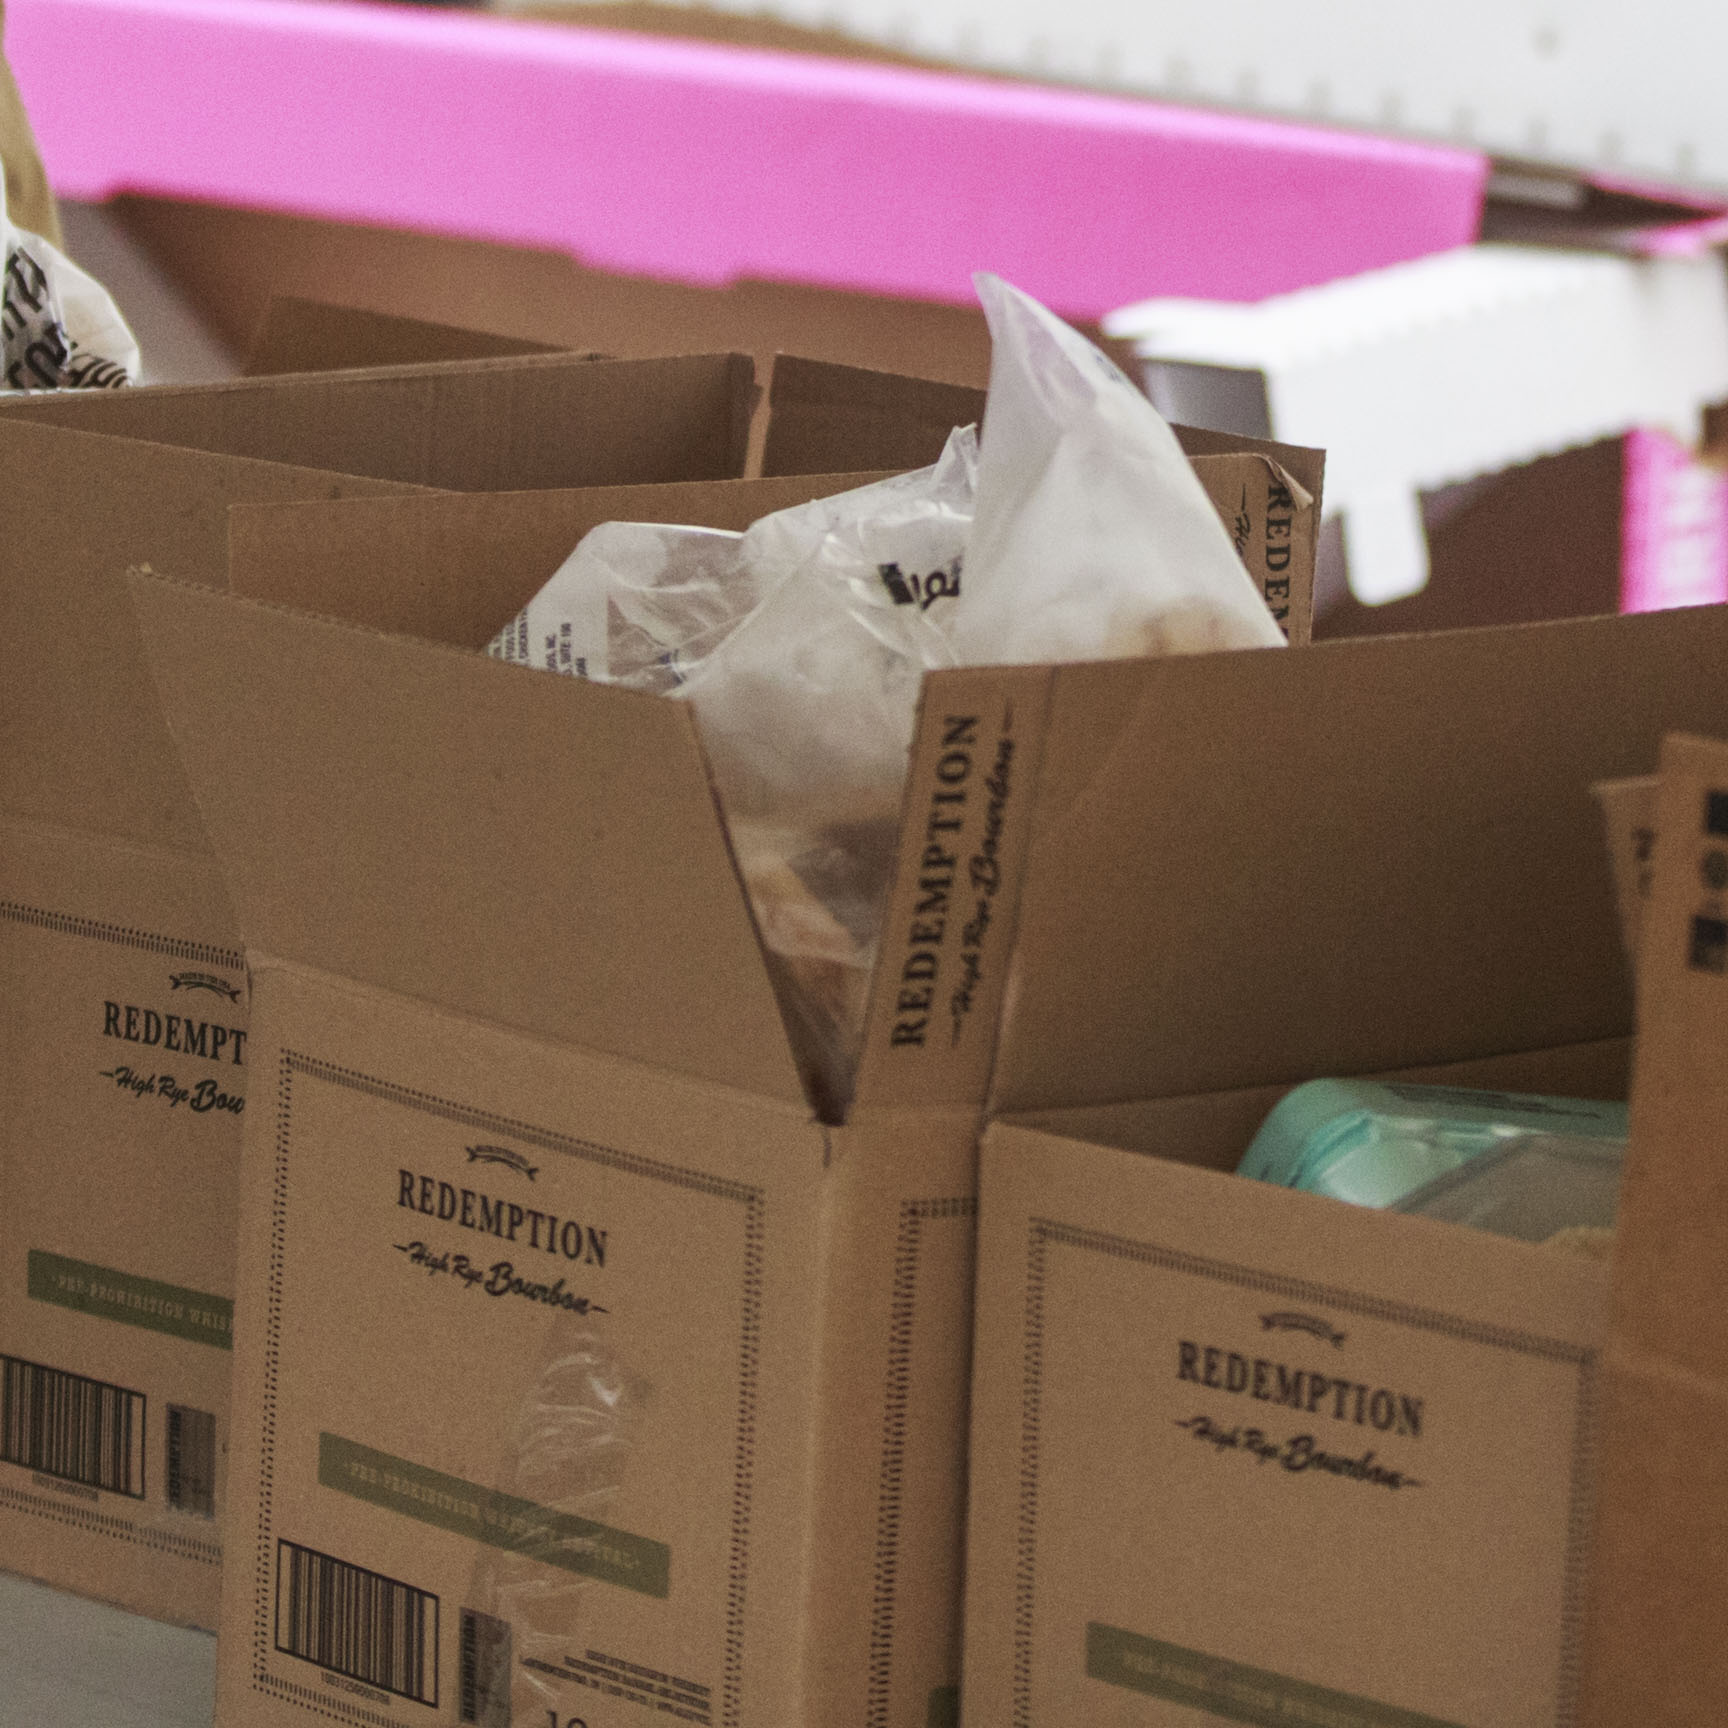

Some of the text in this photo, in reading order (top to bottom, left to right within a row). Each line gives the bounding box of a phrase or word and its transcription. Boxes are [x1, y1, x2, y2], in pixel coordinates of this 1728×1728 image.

[890, 714, 980, 1049] REDEMPTION
[104, 1000, 247, 1065] REDEMPT
[397, 1169, 609, 1268] REDEMPTION
[484, 1261, 591, 1315] Bourbon
[1177, 1339, 1423, 1437] REDEMPTION
